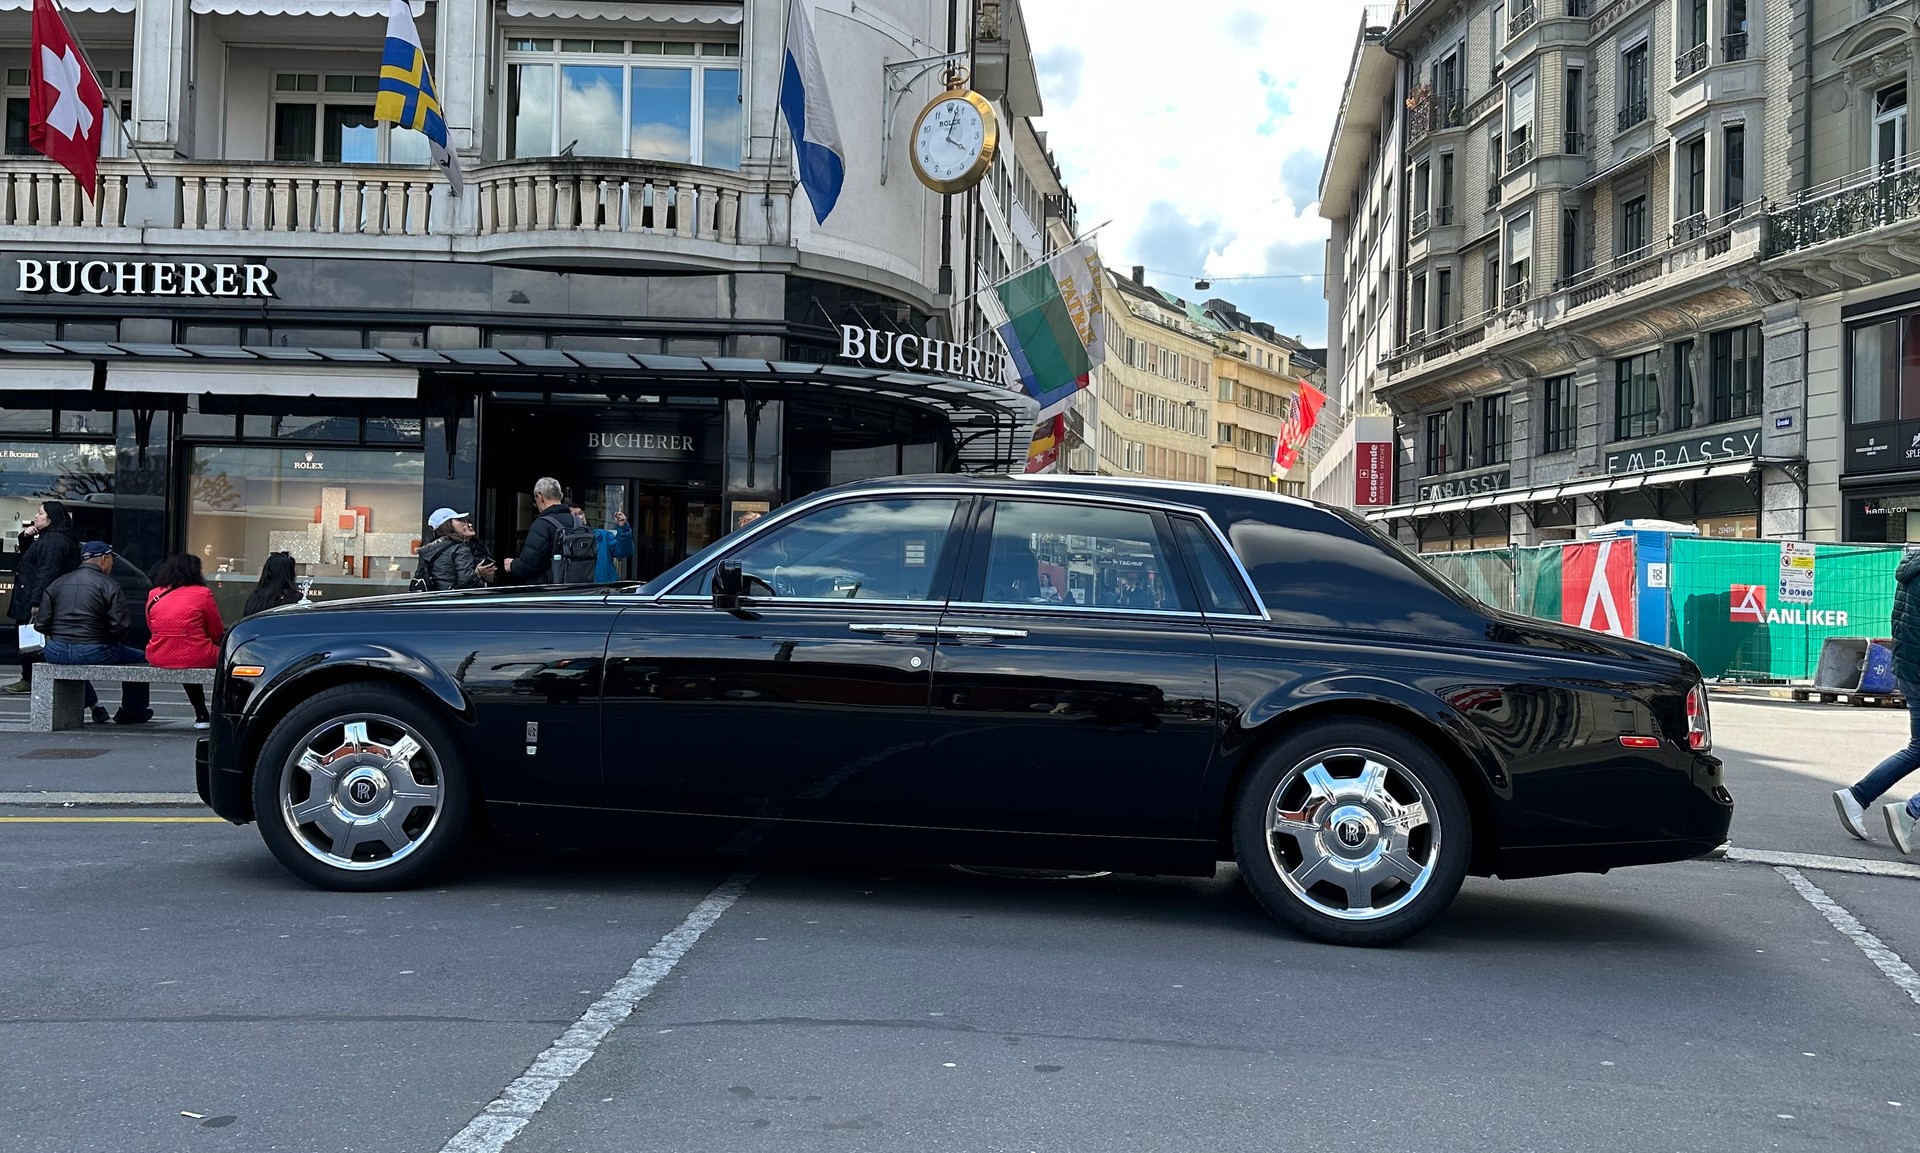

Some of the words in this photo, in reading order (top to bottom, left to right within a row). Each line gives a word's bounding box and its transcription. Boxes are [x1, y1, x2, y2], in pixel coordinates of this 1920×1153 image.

[939, 119, 961, 127] ROLEX
[16, 259, 272, 297] BUCHERER
[1058, 275, 1097, 347] PATRIE
[839, 324, 1008, 386] BUCHERER
[588, 432, 694, 451] BUCHERER
[1608, 433, 1759, 475] EMBASSY
[294, 462, 324, 470] ROLEX
[1369, 444, 1379, 503] Casagrande
[1421, 474, 1503, 500] EMBASSY
[1866, 506, 1908, 515] HAMILTON
[1766, 608, 1848, 626] ANLIKER
